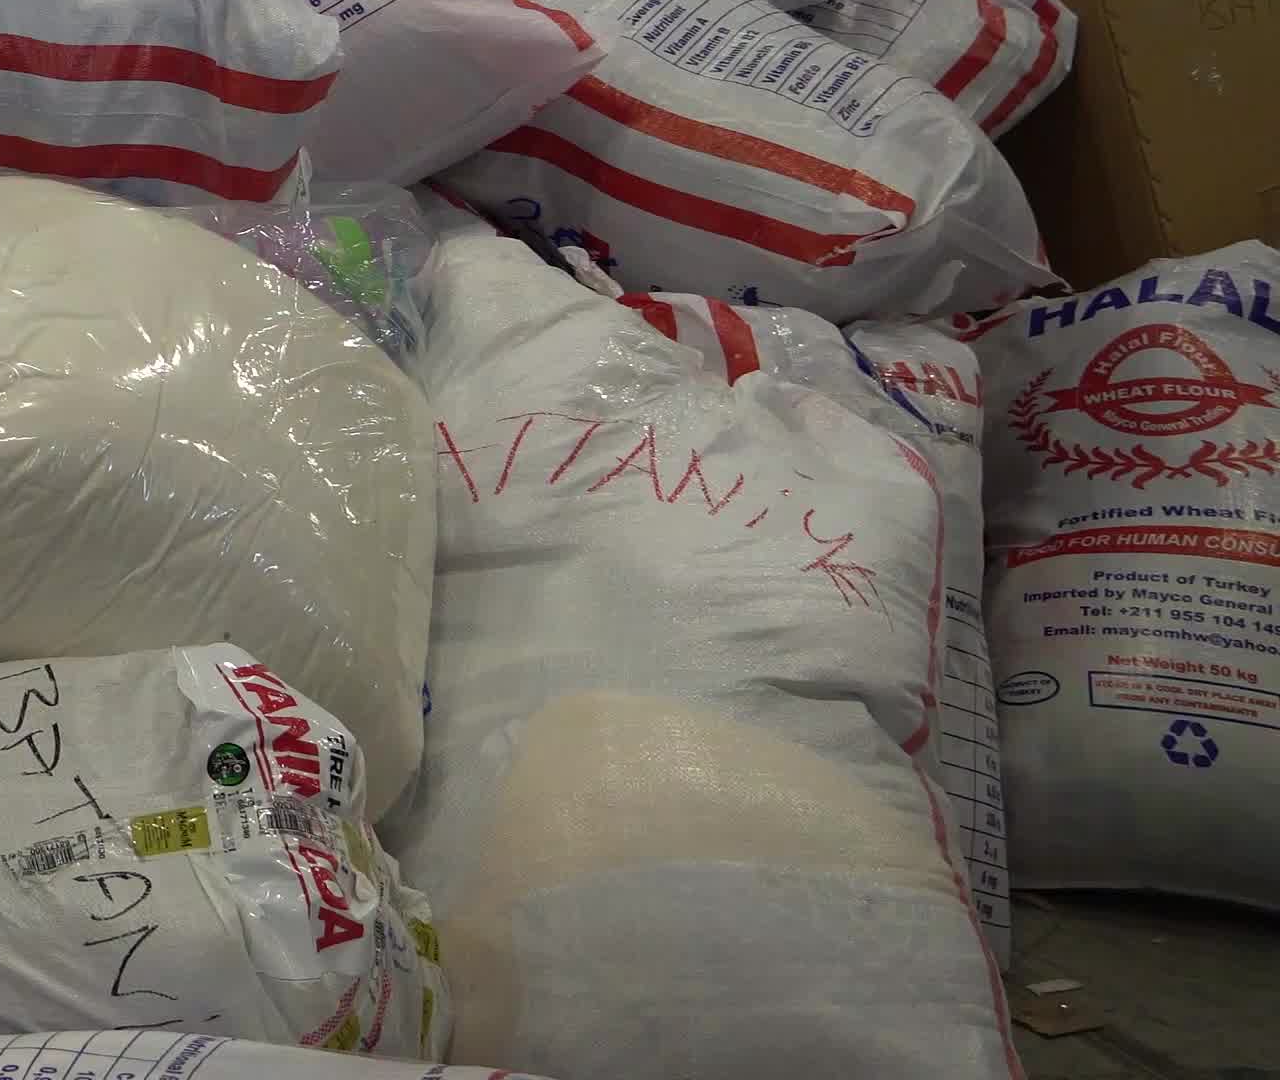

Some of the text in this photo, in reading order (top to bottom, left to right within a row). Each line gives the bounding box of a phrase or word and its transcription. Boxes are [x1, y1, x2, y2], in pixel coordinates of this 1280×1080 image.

[339, 2, 365, 21] mg
[643, 6, 687, 43] Nutritient
[664, 24, 698, 57] Vitamin
[686, 36, 718, 68] Vitamin
[762, 52, 799, 85] Vitamin
[813, 68, 852, 106] Vitamin
[1028, 268, 1280, 338] HALAL
[1094, 330, 1219, 378] Halal Flour
[1083, 383, 1237, 405] WHEAT FLOUR
[1058, 505, 1244, 528] Fortified Wheat
[1067, 532, 1200, 548] FOR HUMAN
[1093, 570, 1272, 598] Product Turkey
[1023, 587, 1274, 616] Imported by Mayco General
[1043, 625, 1097, 638] Email:
[1080, 605, 1247, 630] Tel: +211 955 104
